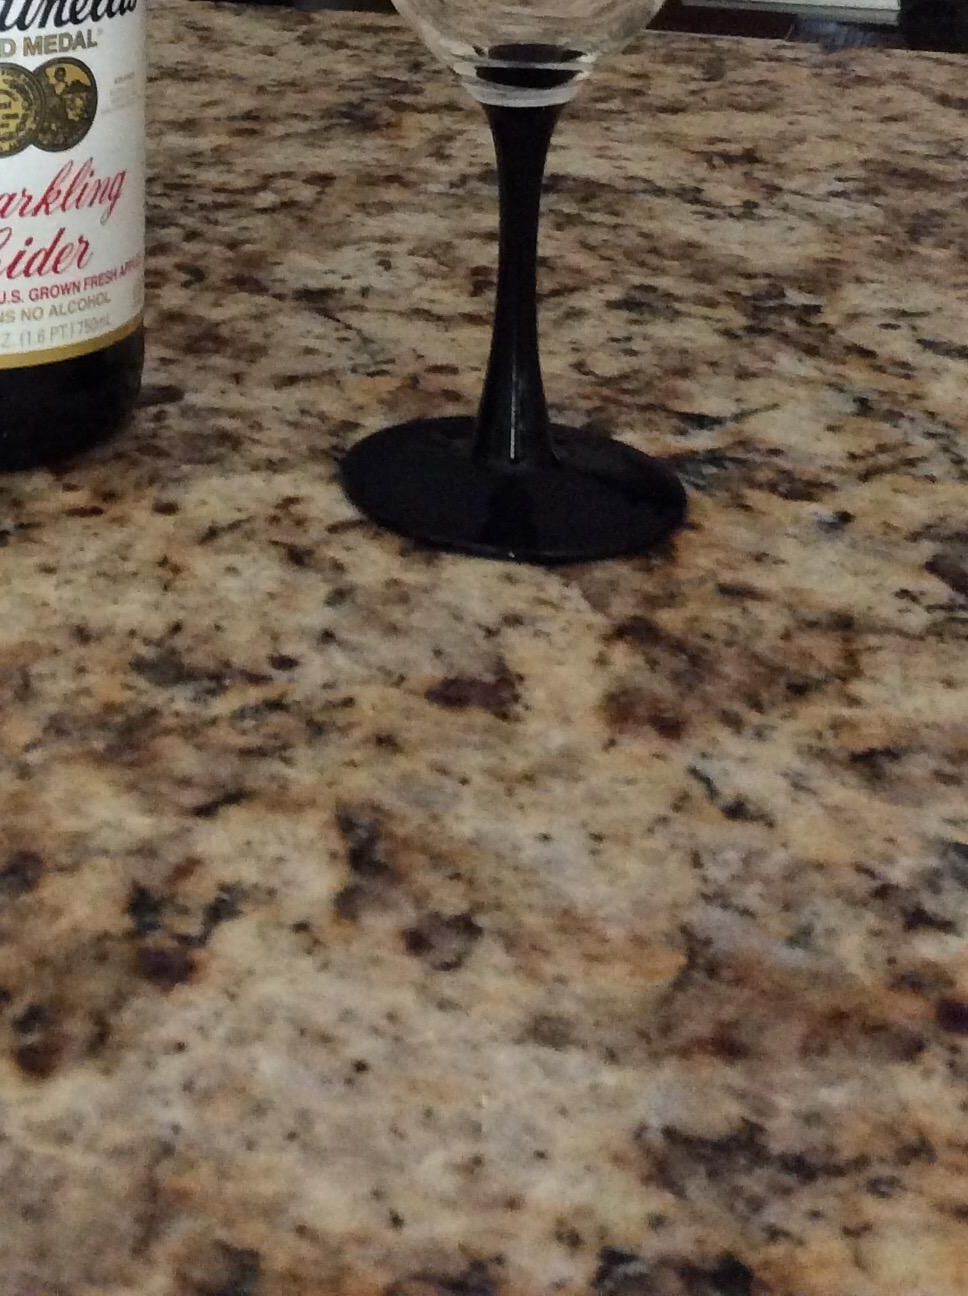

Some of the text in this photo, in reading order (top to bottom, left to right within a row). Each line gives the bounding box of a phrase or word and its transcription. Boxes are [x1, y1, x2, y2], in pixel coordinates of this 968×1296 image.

[23, 29, 98, 57] MEDAL
[28, 281, 81, 302] GROWN
[83, 268, 118, 291] FRESH
[20, 306, 45, 322] NO
[48, 292, 112, 318] ALCOHOL
